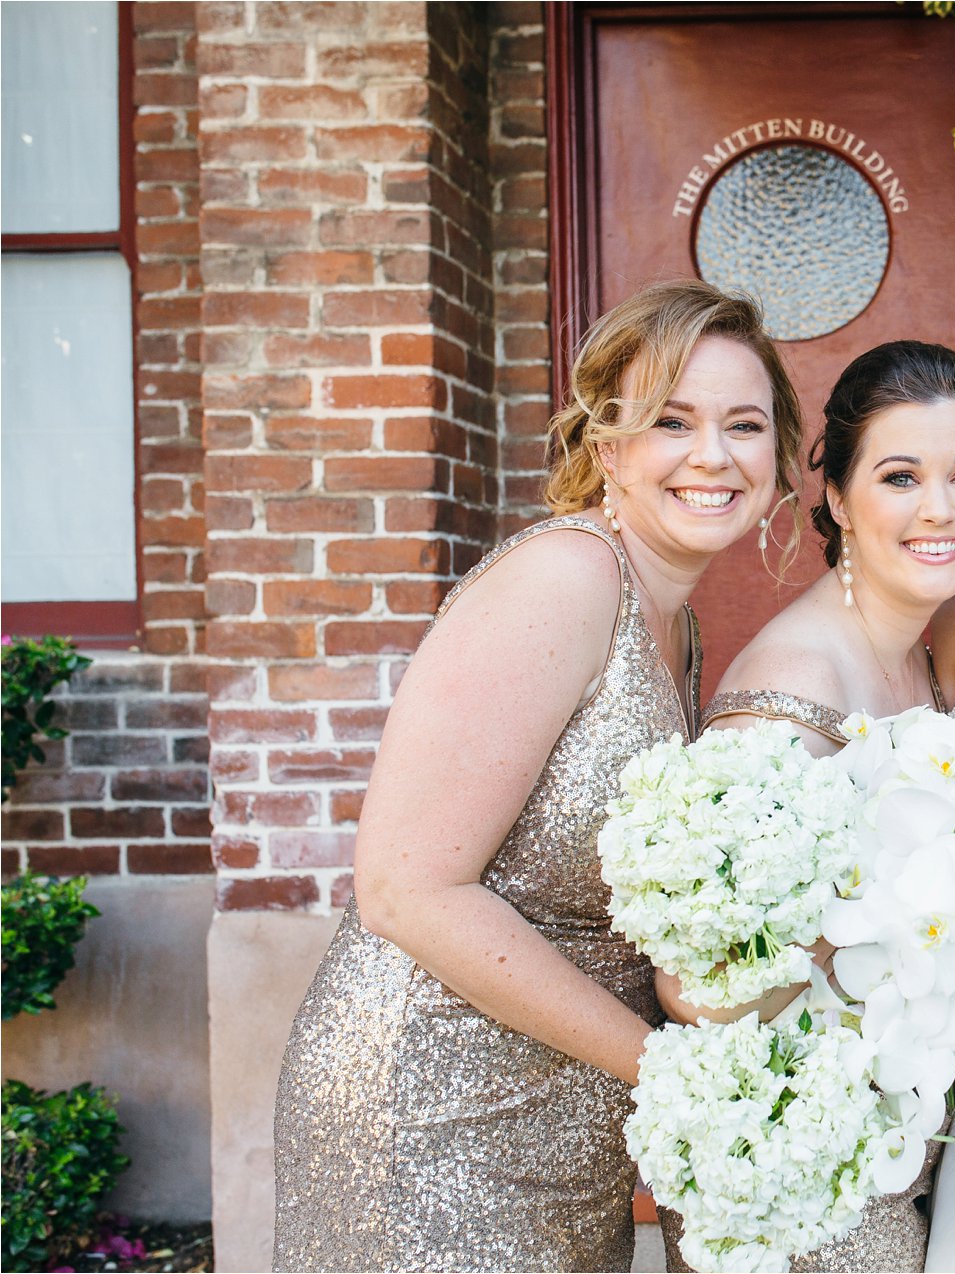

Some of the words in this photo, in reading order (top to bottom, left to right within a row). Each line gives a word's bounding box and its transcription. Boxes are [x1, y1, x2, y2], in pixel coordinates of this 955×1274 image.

[672, 165, 709, 218] THE
[702, 118, 803, 170] MITTEN
[808, 119, 909, 214] BUILDING
